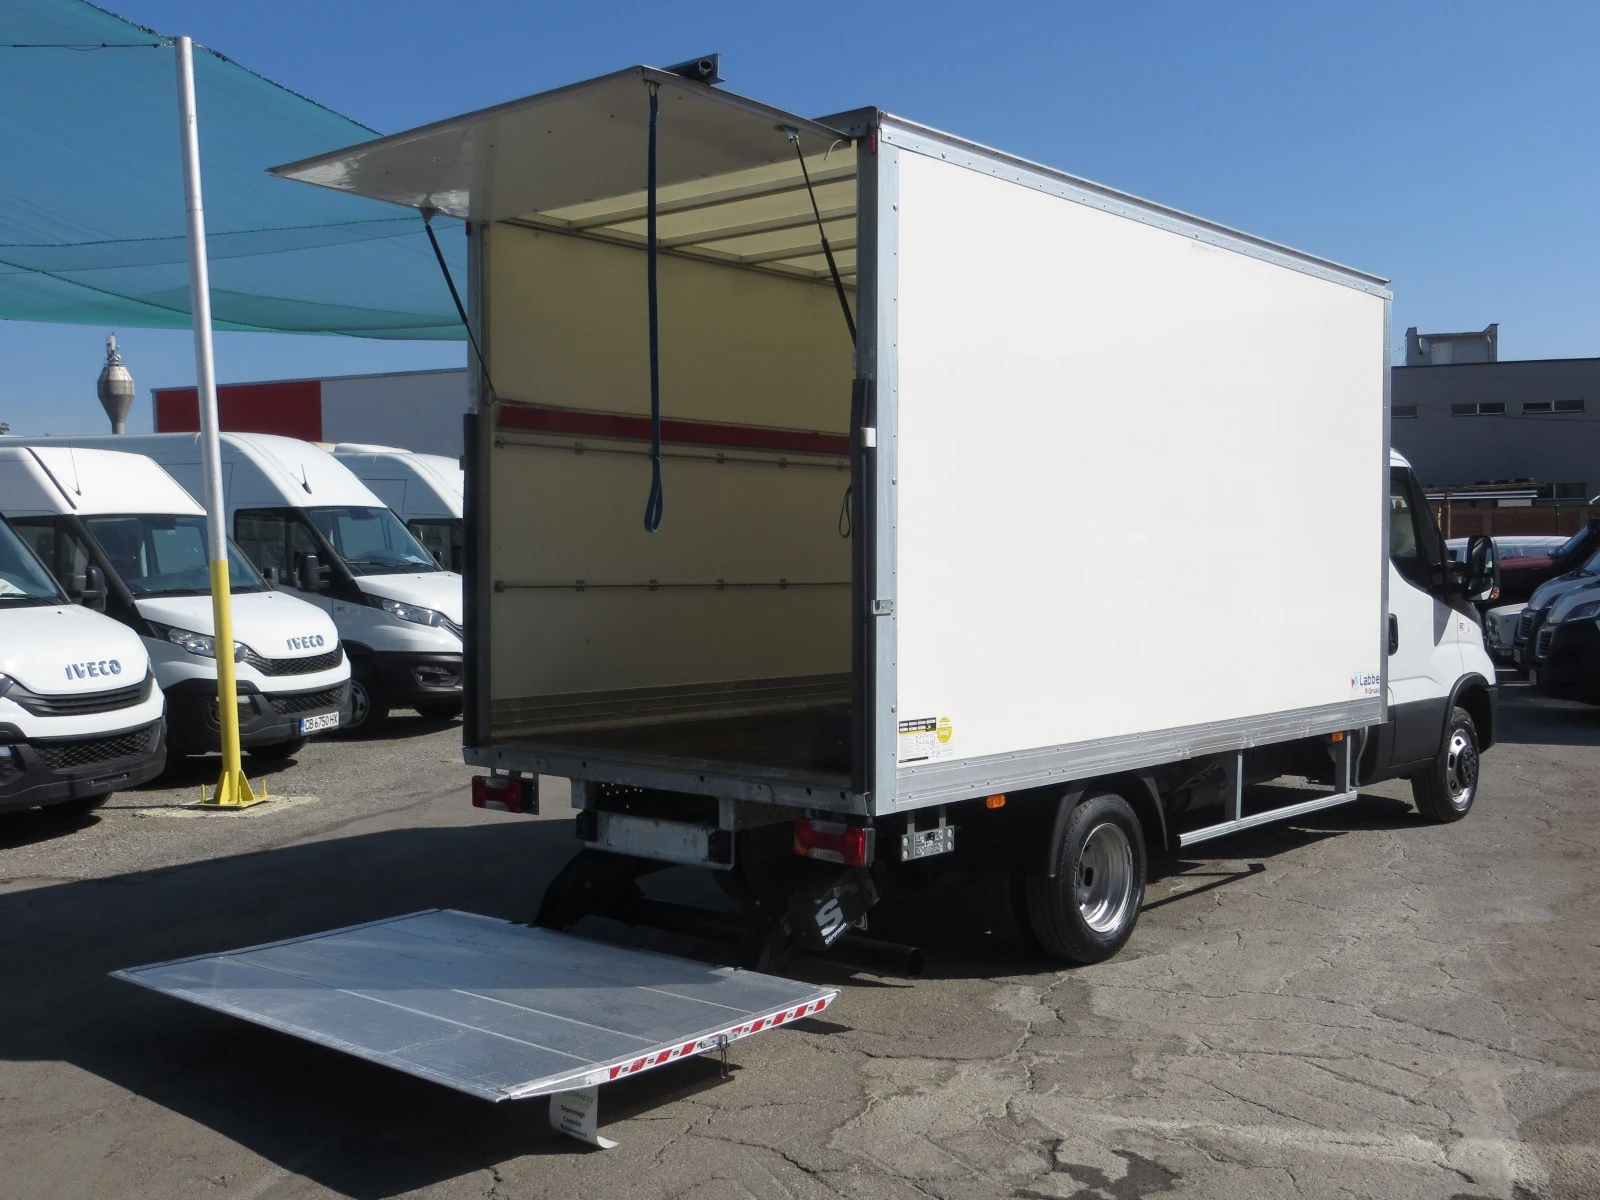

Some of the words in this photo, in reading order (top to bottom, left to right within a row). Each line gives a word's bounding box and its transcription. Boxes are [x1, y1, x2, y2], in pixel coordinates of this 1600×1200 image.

[287, 635, 325, 651] IVECO
[65, 660, 121, 680] IVECO
[314, 716, 330, 728] 6750
